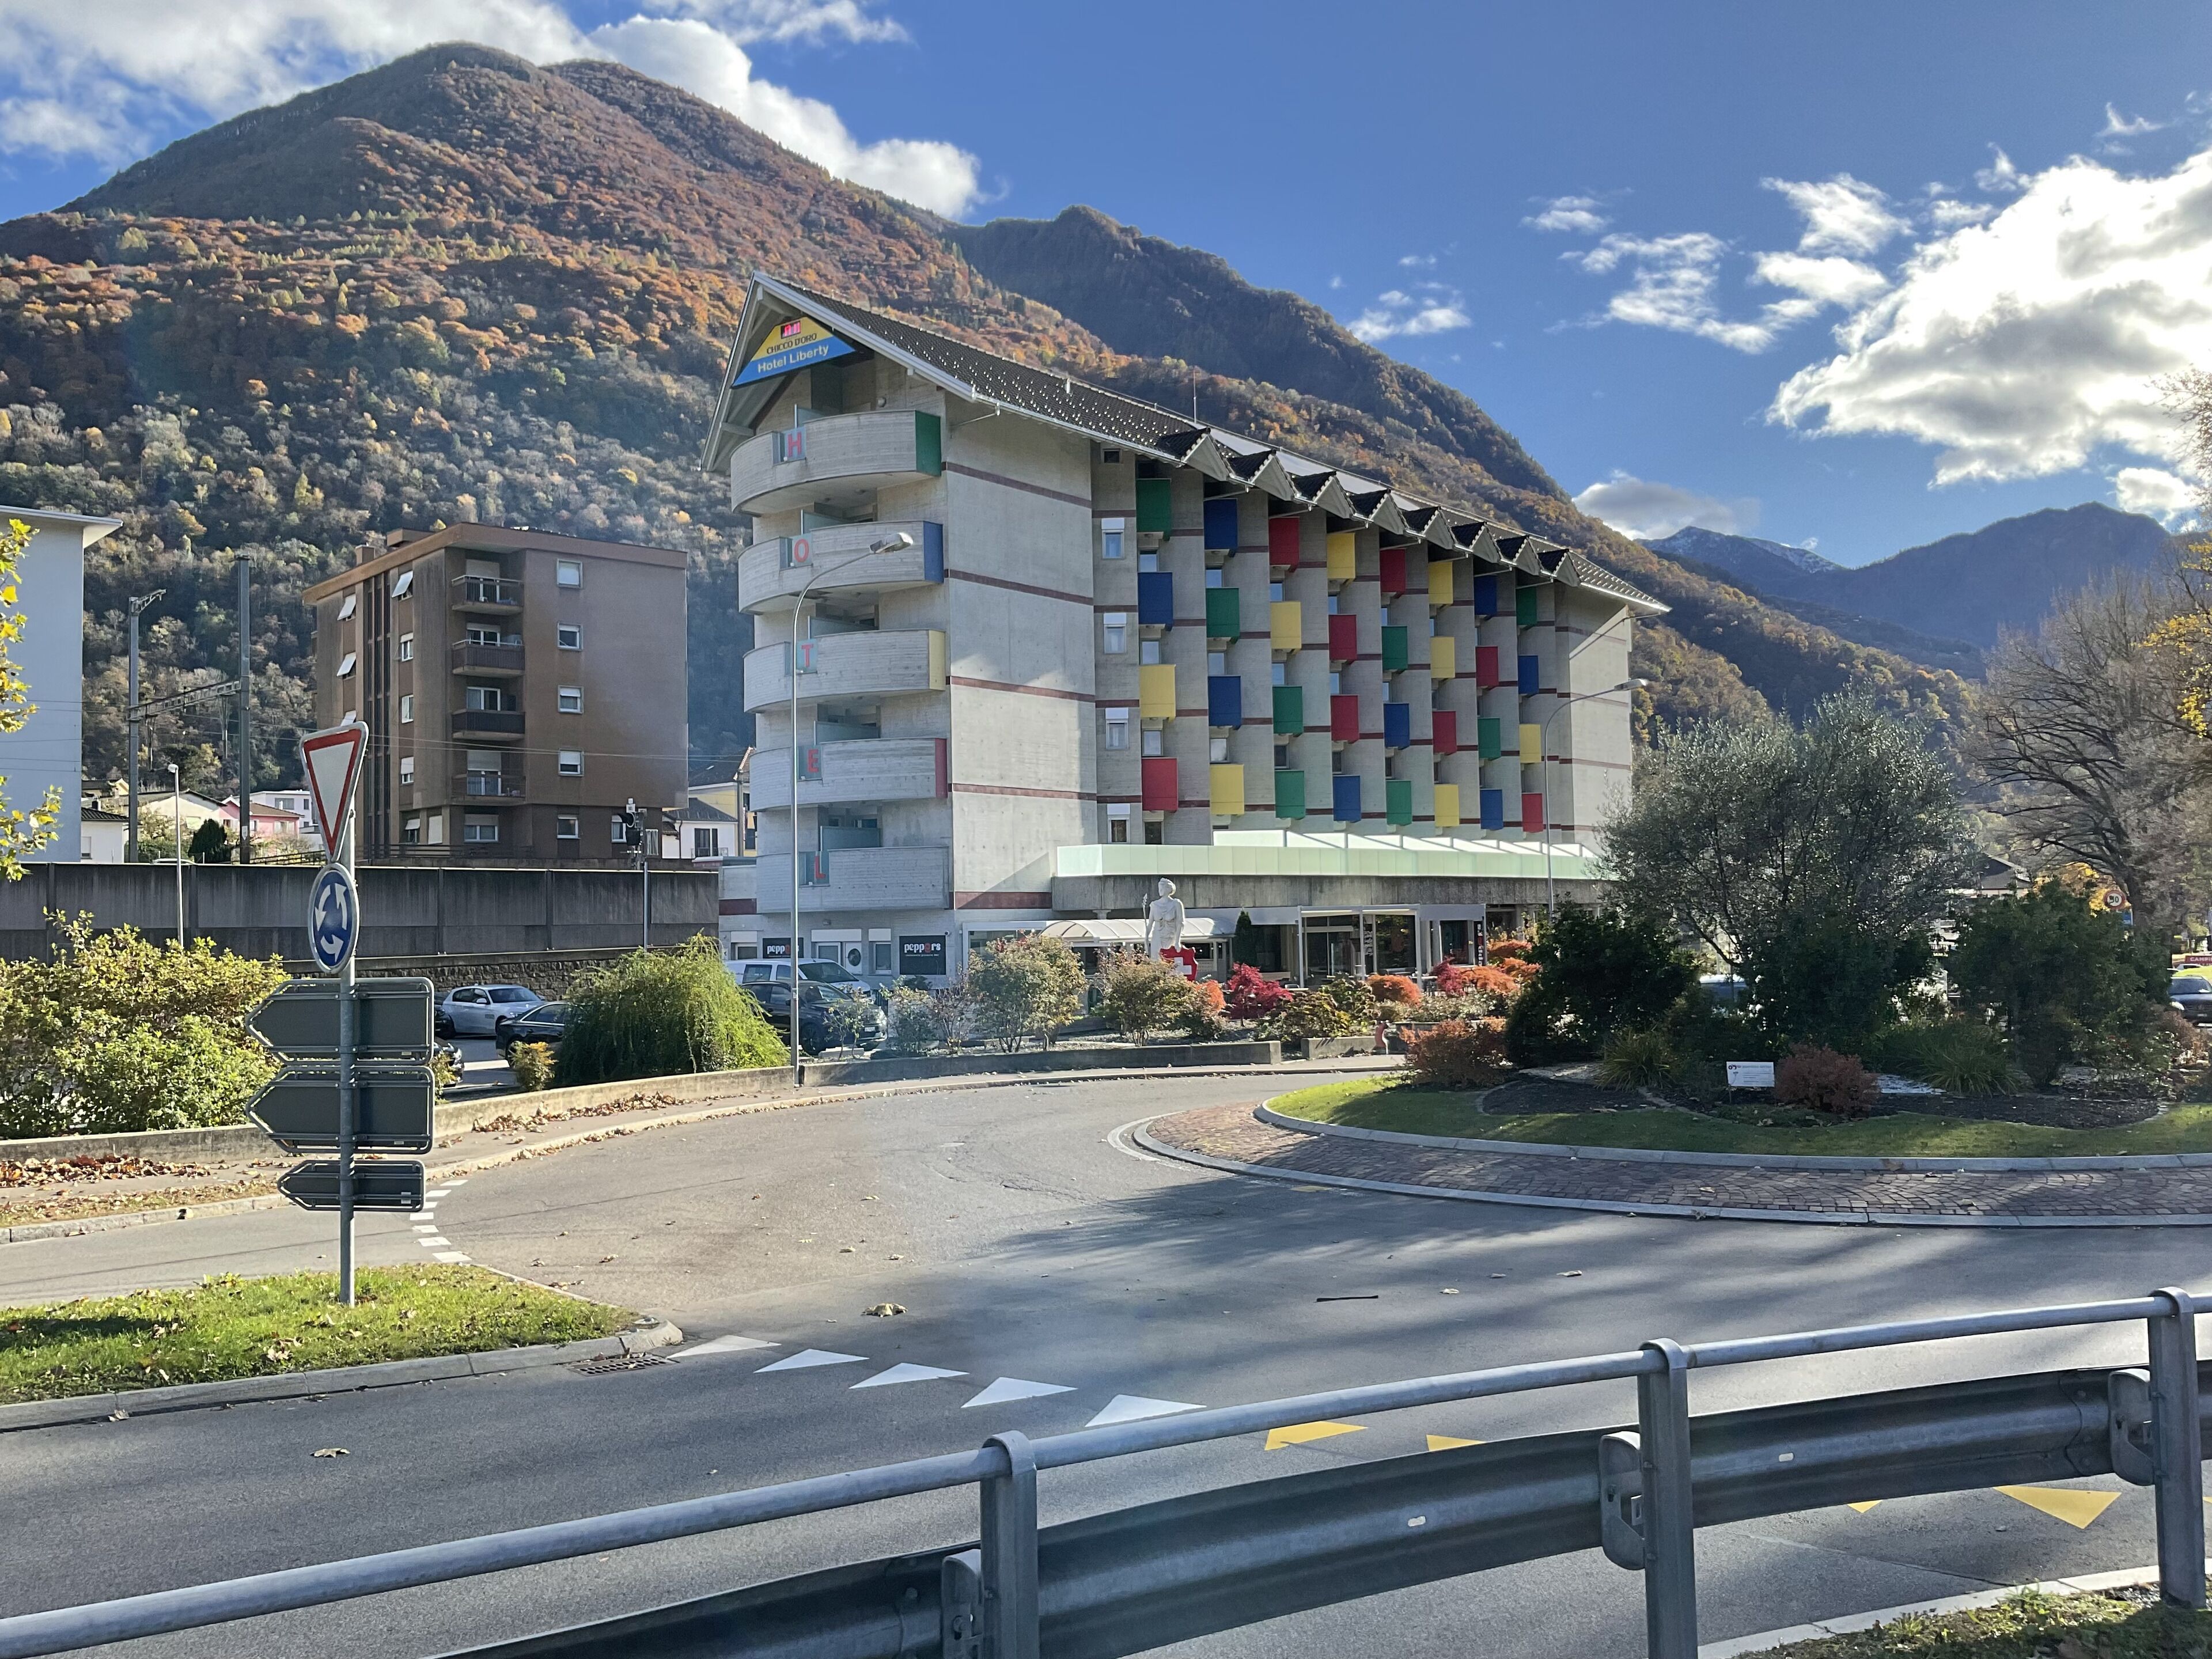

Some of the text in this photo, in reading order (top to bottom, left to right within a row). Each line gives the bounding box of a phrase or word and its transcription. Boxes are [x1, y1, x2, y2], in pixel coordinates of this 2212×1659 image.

[767, 340, 793, 354] CHICCO
[757, 345, 829, 373] Hotel Liberty
